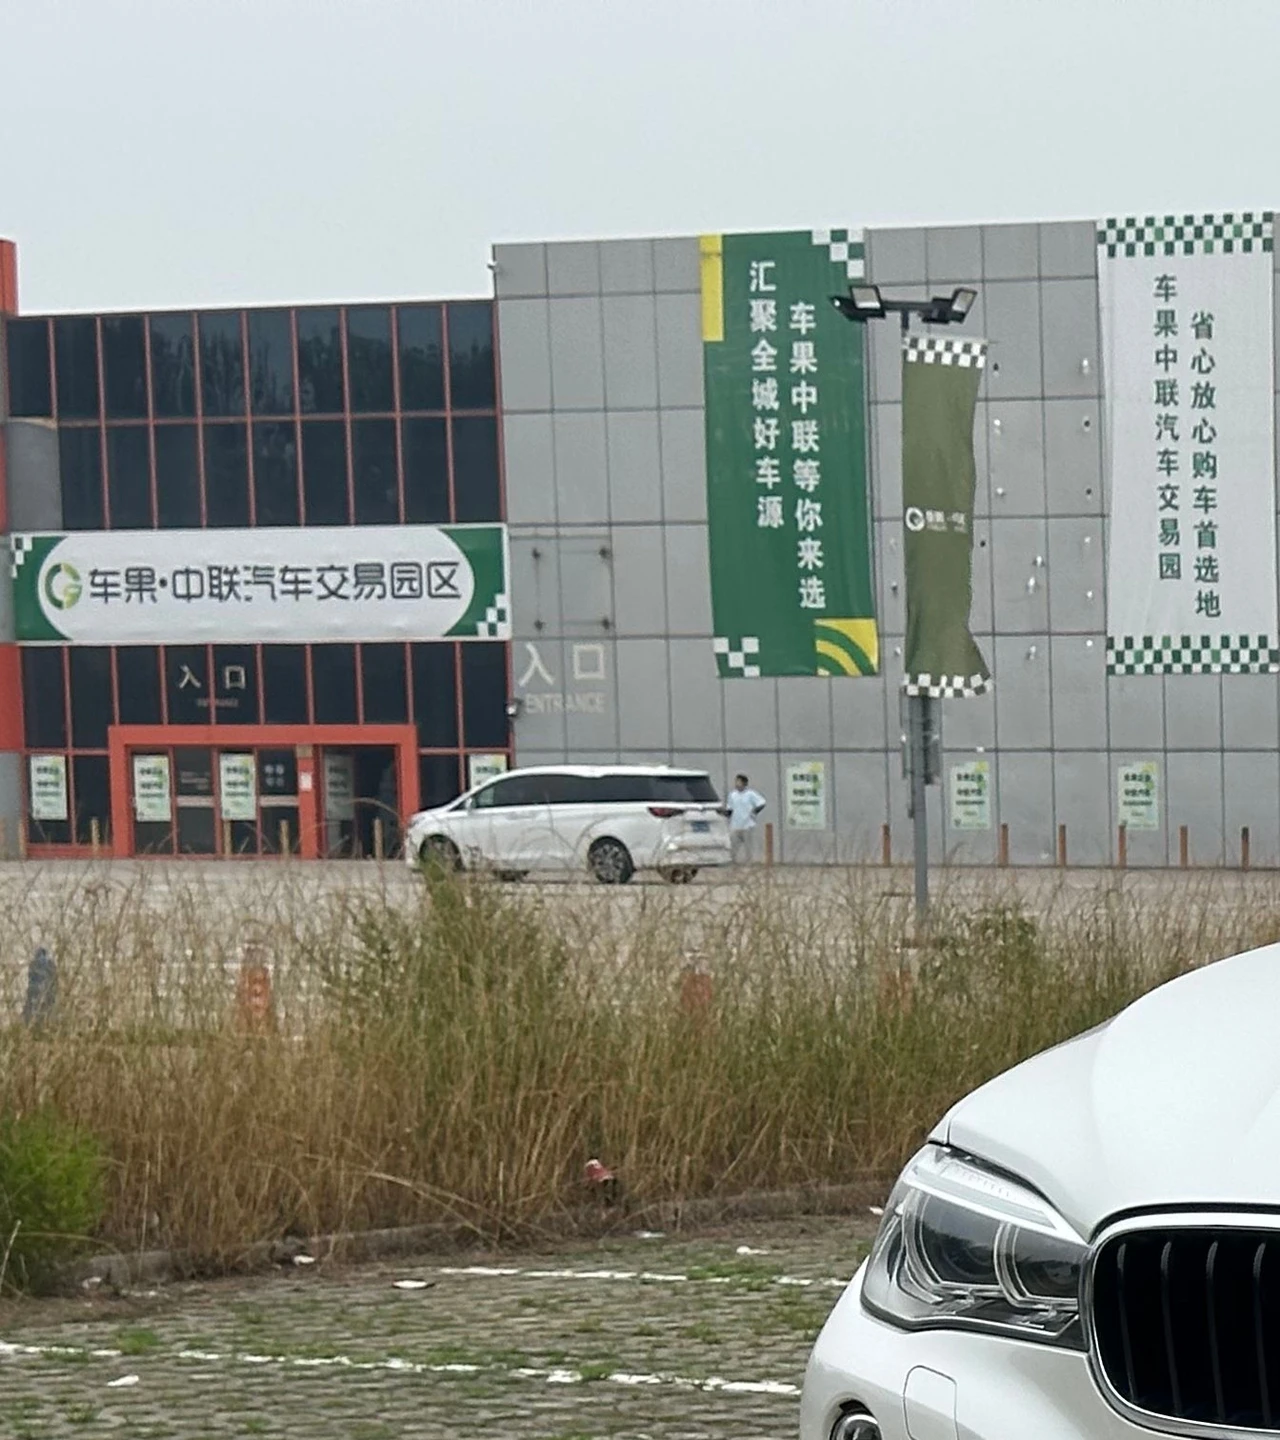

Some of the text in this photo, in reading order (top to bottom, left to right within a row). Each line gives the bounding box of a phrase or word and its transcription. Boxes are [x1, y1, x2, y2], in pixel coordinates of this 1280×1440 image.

[750, 260, 785, 529] 汇聚全城好车源
[789, 301, 827, 609] 车果中联等你来选
[1153, 273, 1182, 580] 车果中联汽车交易园
[1190, 309, 1222, 618] 省心放心购车首选地
[88, 560, 463, 604] 车果·中联汽车交易园区
[178, 664, 247, 690] 入口
[518, 642, 606, 687] 入口
